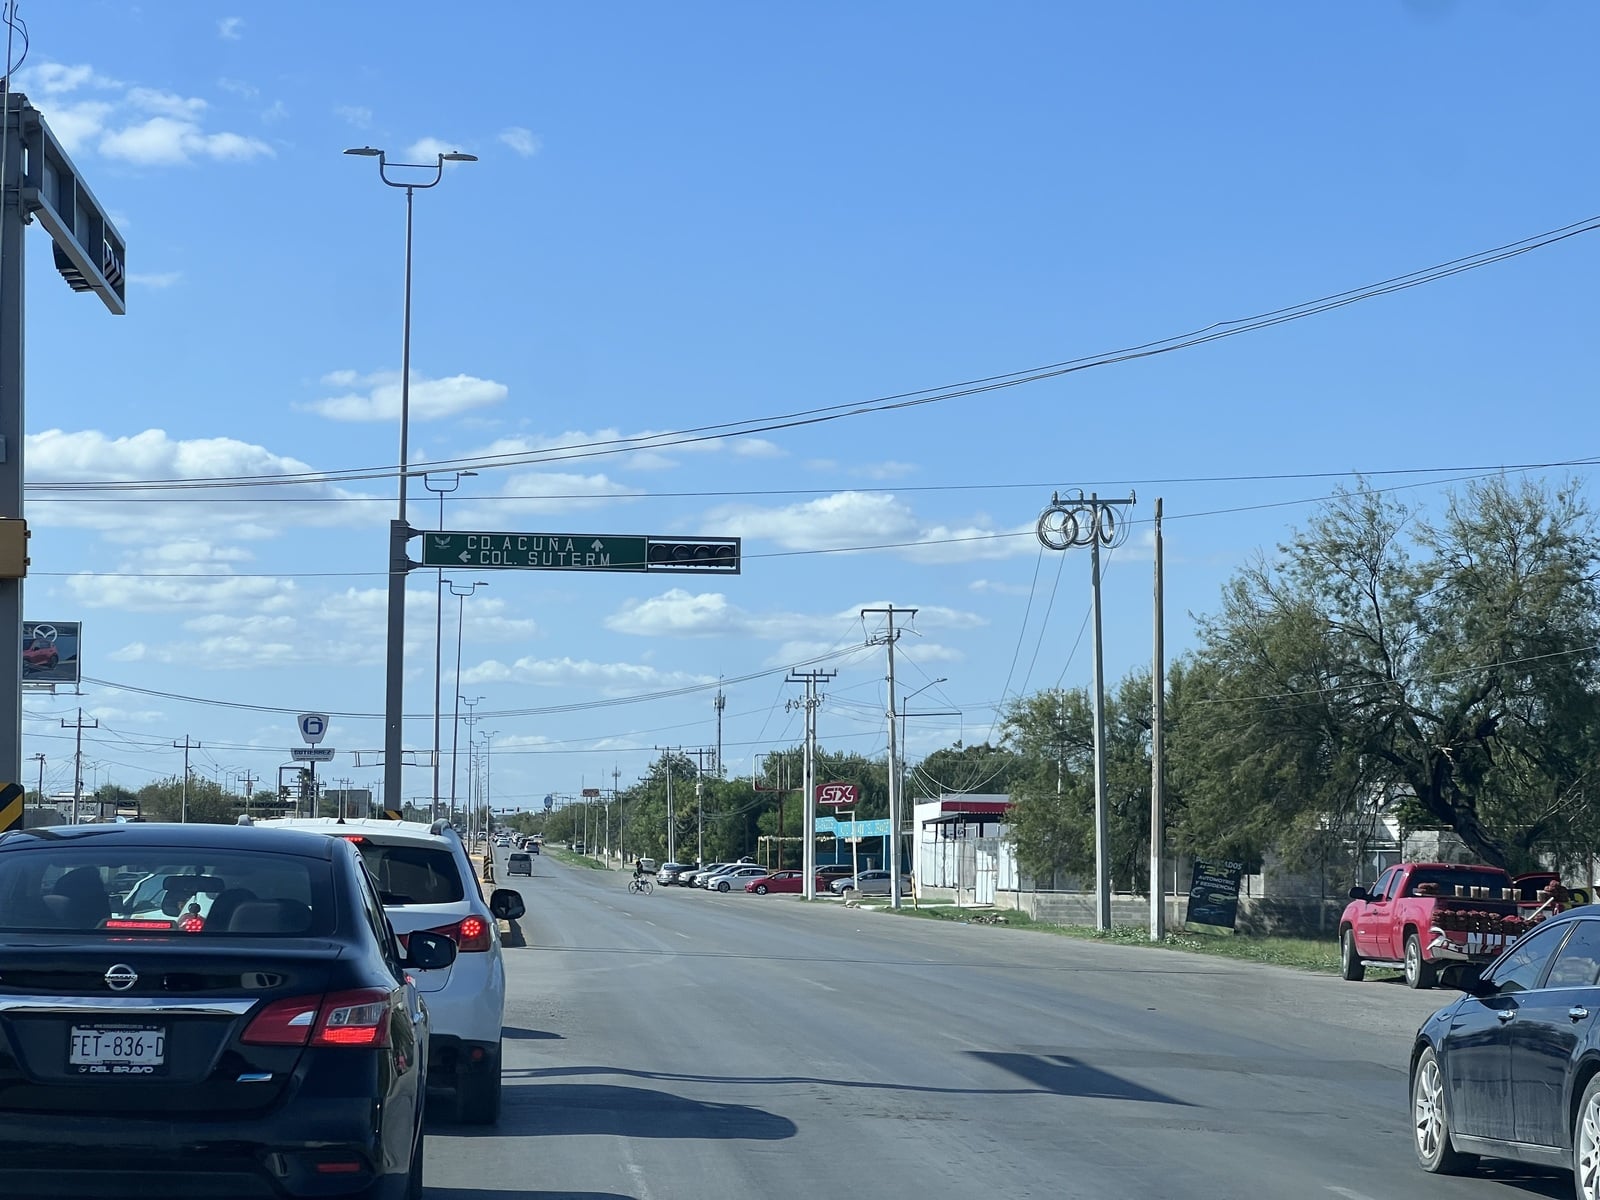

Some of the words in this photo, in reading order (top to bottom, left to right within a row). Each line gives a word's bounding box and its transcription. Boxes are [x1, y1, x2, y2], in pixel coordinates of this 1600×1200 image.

[467, 535, 494, 550] CD.
[502, 536, 574, 552] ACUÑA
[480, 550, 518, 565] COL.
[528, 552, 610, 567] SUTERM
[71, 1035, 164, 1057] FET-836-D
[90, 1065, 110, 1073] DEL
[112, 1065, 154, 1074] BRAVO
